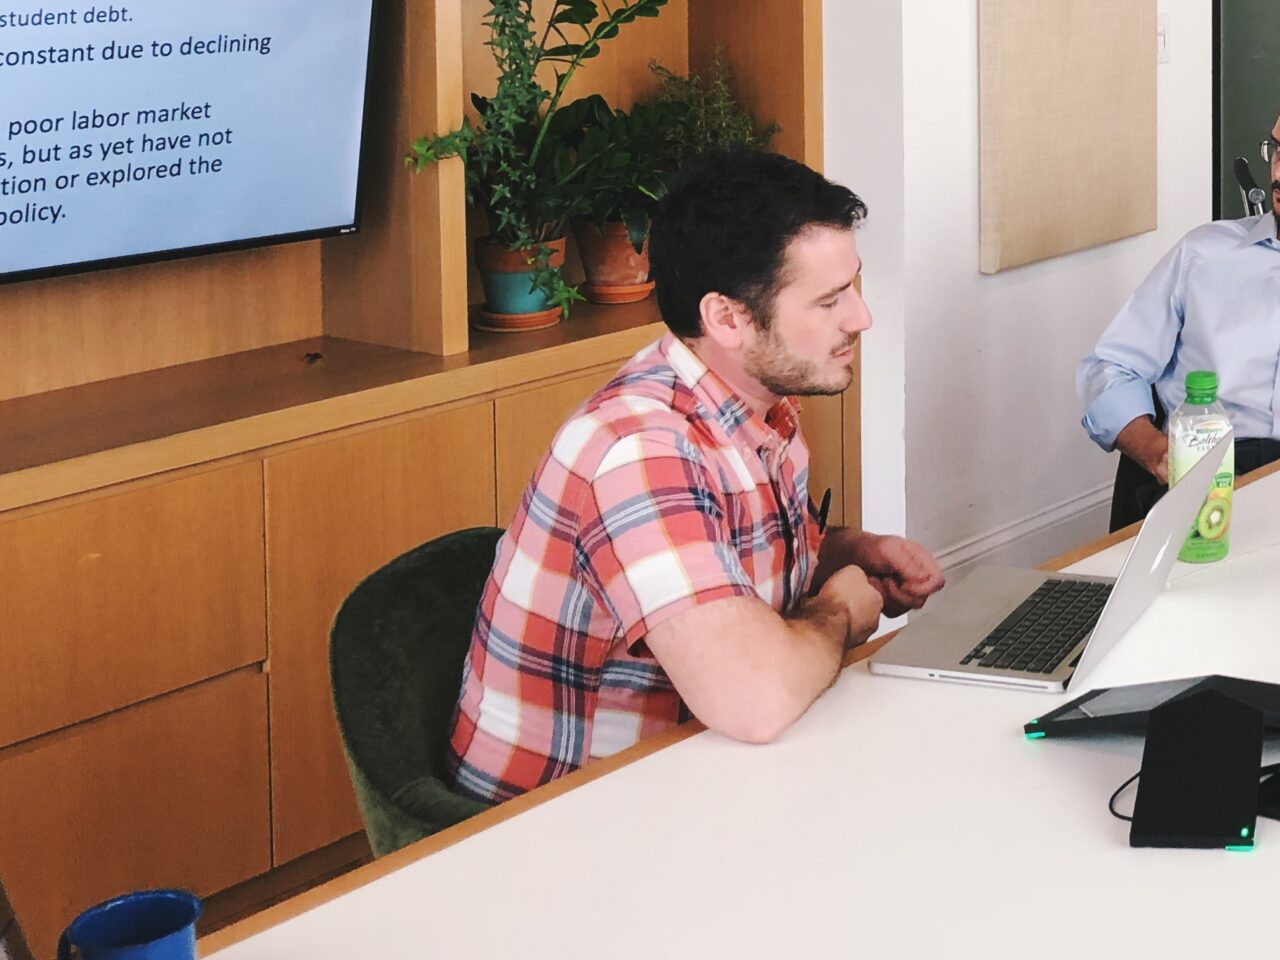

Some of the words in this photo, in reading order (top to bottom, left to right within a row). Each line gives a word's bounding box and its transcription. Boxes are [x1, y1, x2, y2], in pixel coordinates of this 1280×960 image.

[0, 7, 78, 28] student
[82, 4, 134, 24] debt.
[101, 39, 144, 61] due
[150, 40, 173, 58] to
[179, 33, 272, 58] declining
[7, 116, 65, 142] poor
[71, 108, 131, 131] labor
[136, 101, 213, 125] market
[22, 143, 63, 165] but
[68, 144, 93, 160] as
[99, 136, 135, 162] yet
[141, 131, 192, 153] have
[197, 127, 233, 148] not
[0, 175, 47, 196] tion
[54, 173, 81, 190] or
[85, 157, 183, 189] explored
[188, 154, 223, 176] the
